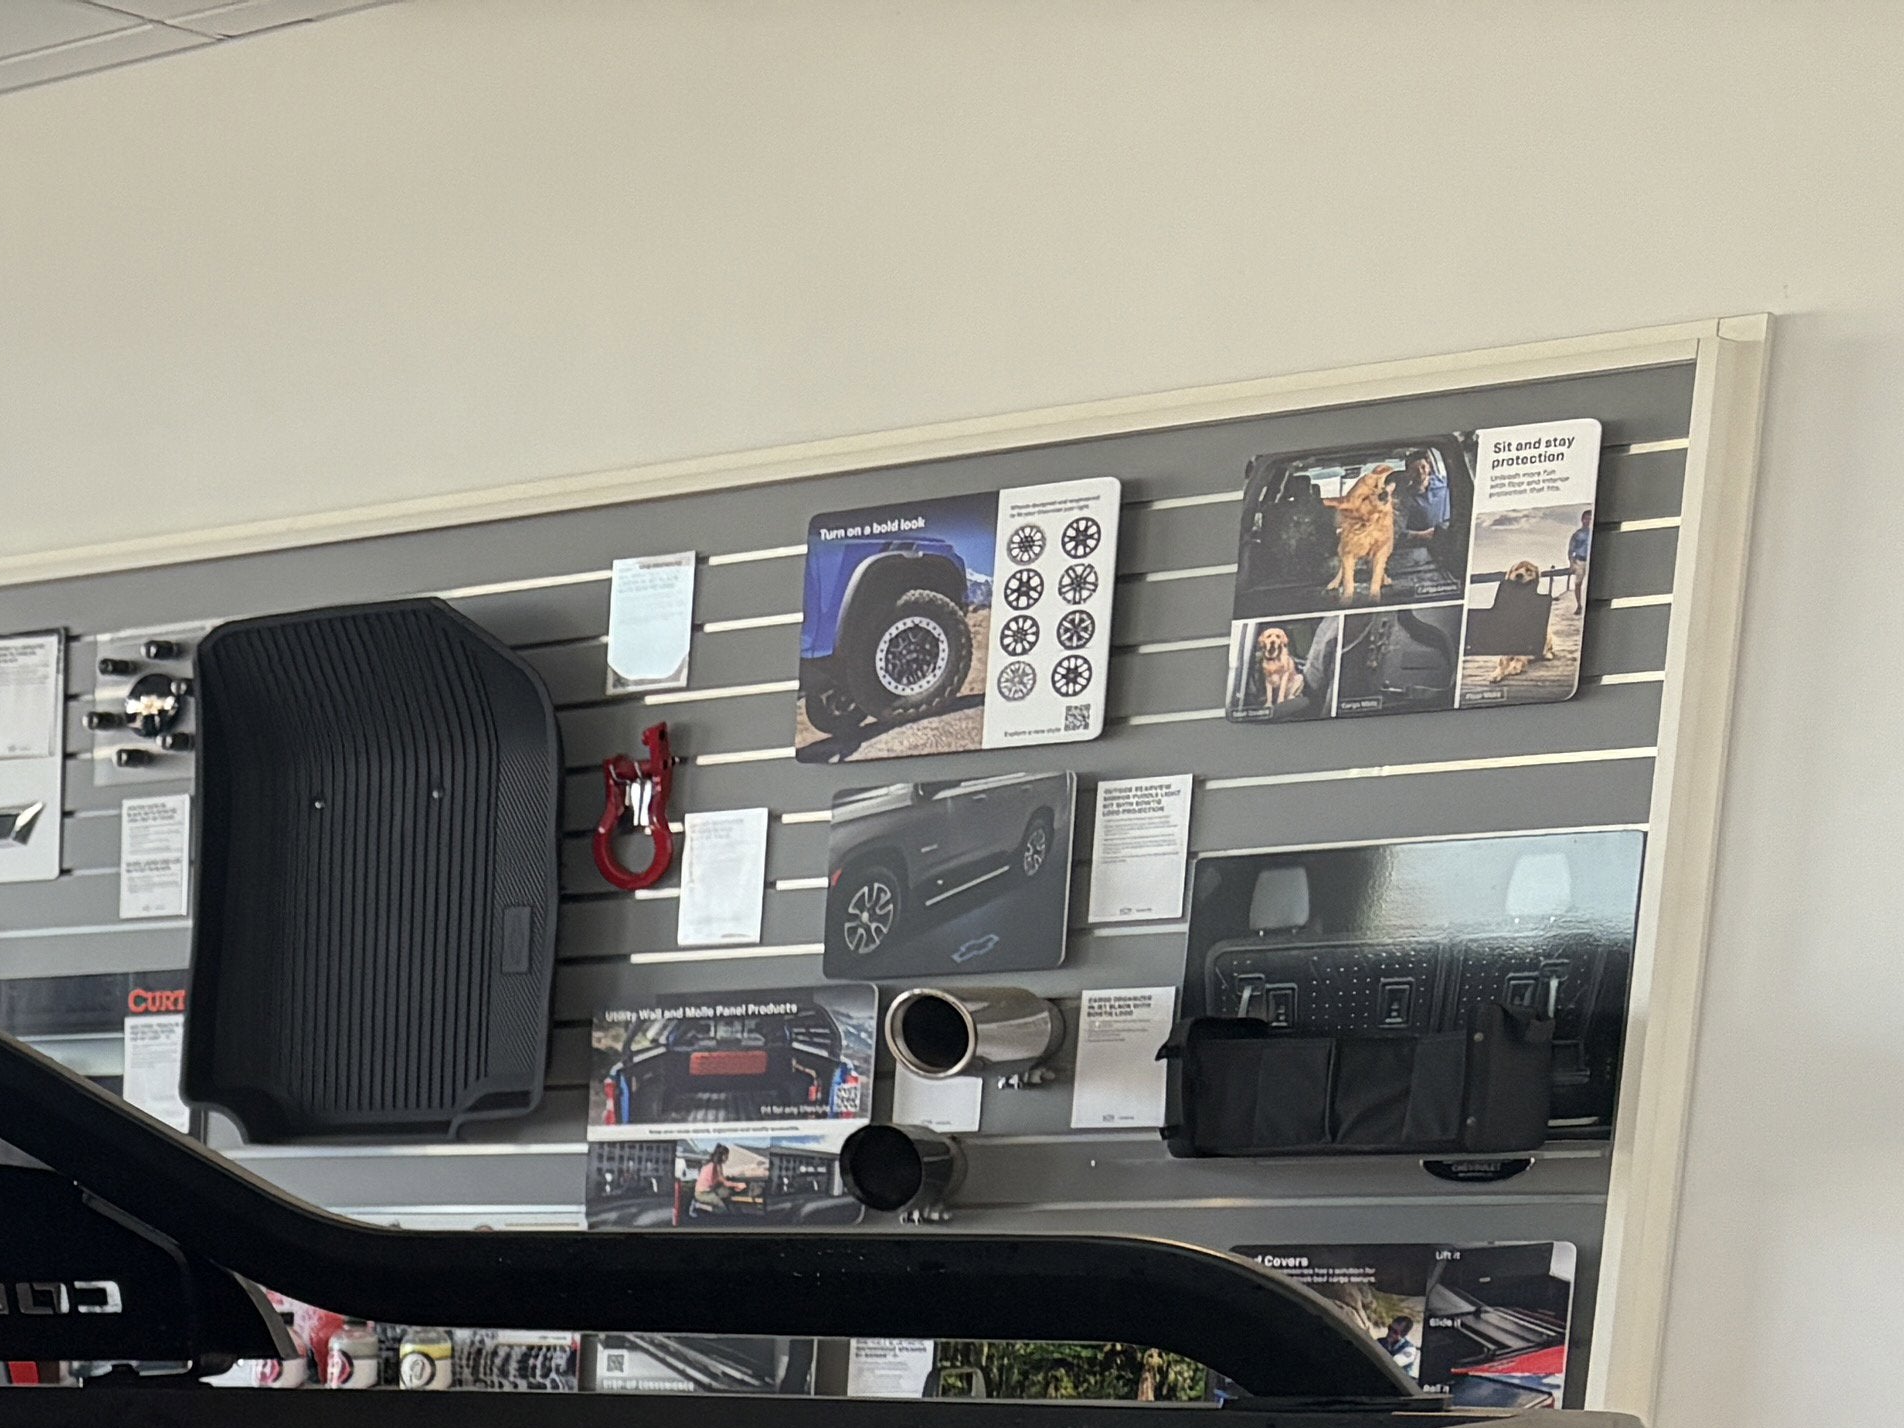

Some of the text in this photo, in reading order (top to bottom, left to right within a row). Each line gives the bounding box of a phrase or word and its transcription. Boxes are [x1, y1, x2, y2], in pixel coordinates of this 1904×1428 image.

[1493, 436, 1575, 454] Sit and stay
[1492, 451, 1565, 470] protection
[820, 516, 926, 540] Turn on a bold look
[605, 1002, 798, 1024] Utility Wall and Molle Panel Products
[1264, 1254, 1309, 1268] Covers
[1435, 1251, 1451, 1260] Lift
